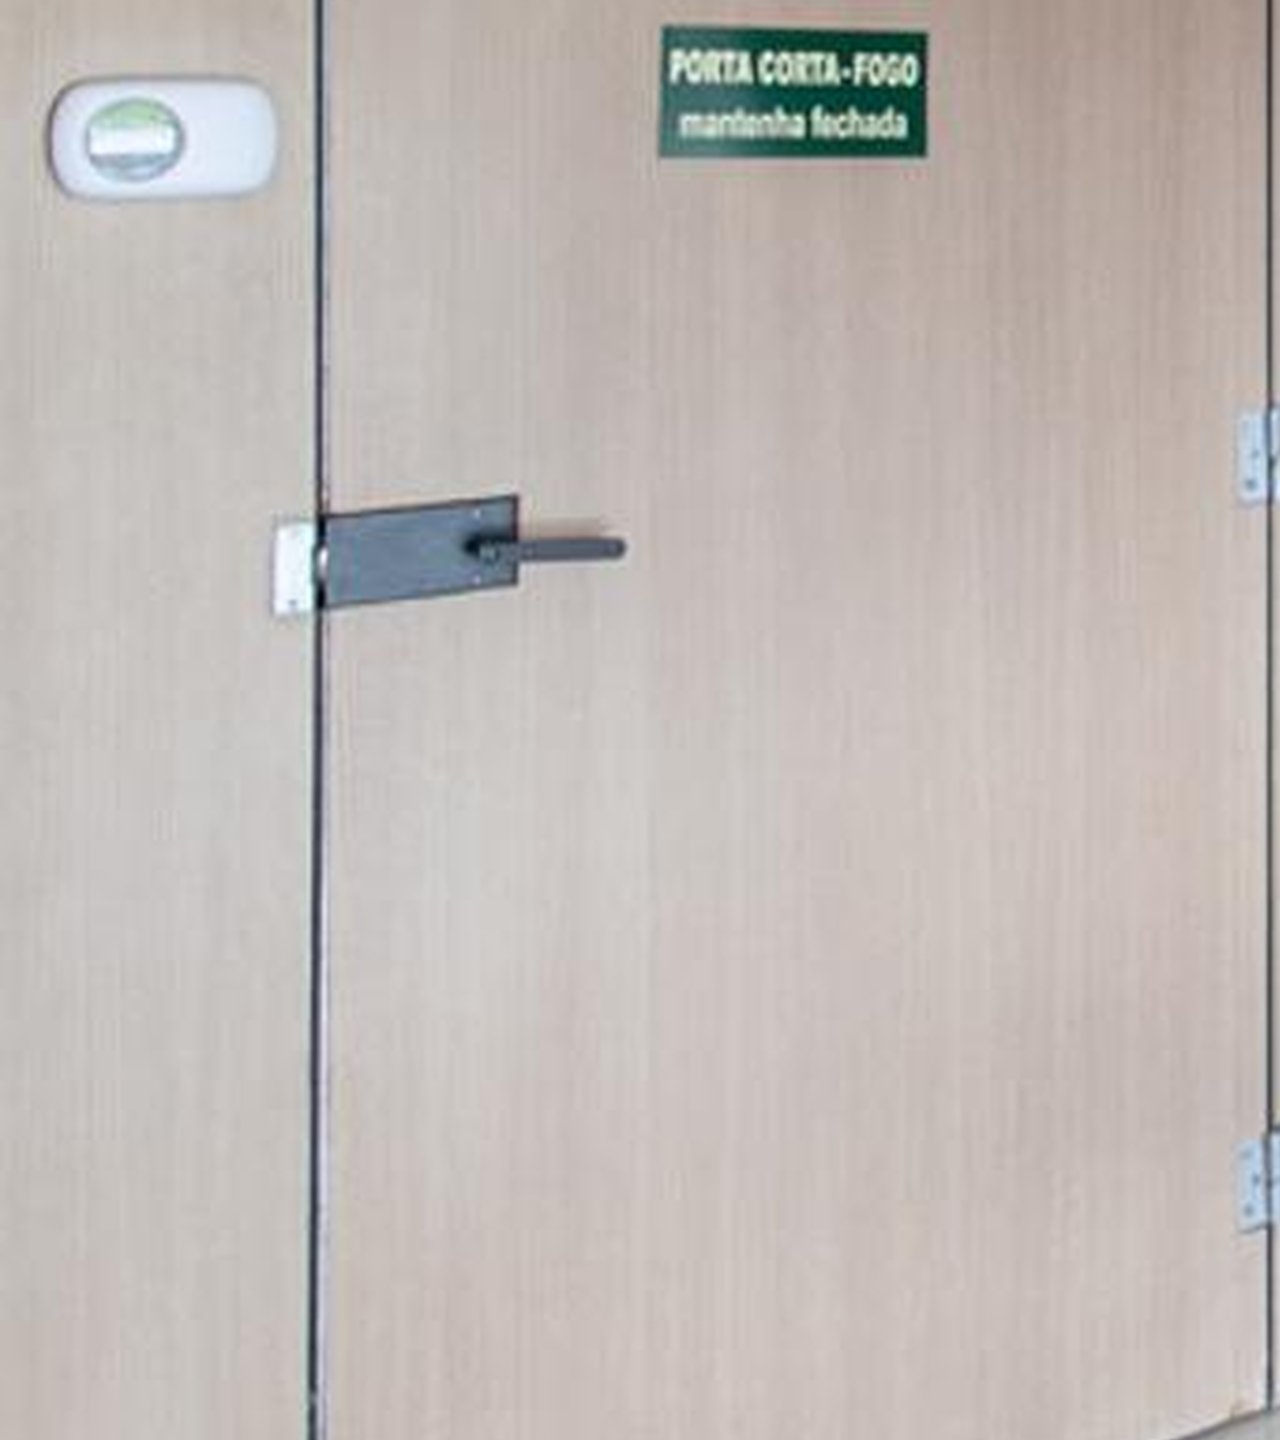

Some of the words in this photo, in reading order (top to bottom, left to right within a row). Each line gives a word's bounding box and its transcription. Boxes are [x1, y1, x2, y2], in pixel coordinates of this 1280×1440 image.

[668, 47, 752, 84] PORTA
[680, 106, 806, 139] mantenha
[810, 105, 908, 139] fechada
